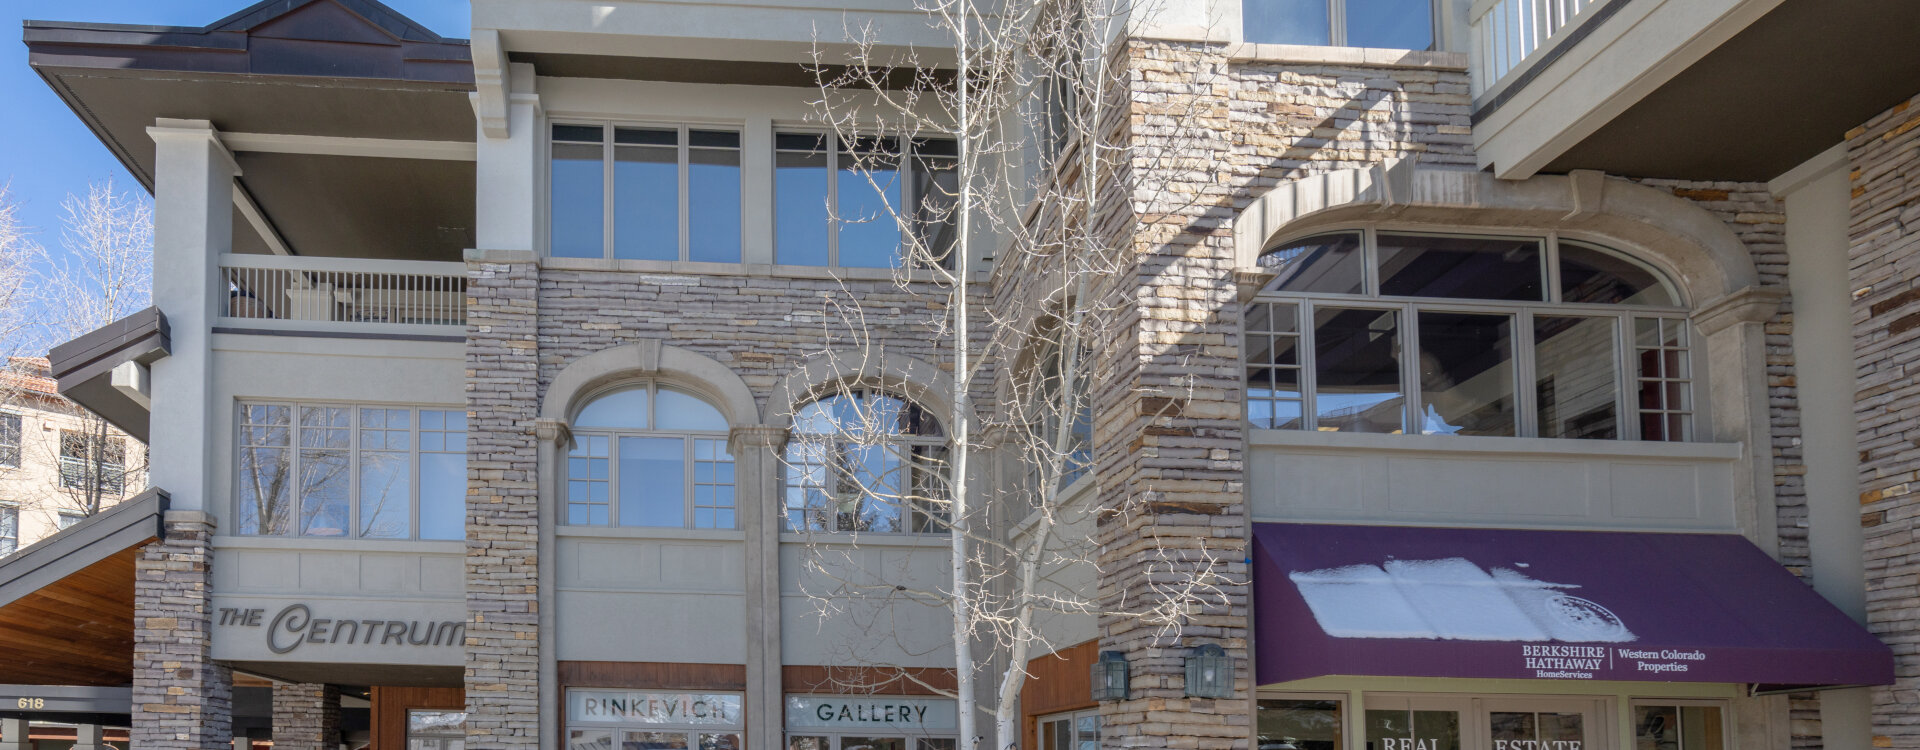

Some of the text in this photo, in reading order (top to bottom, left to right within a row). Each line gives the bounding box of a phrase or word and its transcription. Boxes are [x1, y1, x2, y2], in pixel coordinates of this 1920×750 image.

[219, 608, 264, 626] THE
[1522, 645, 1605, 658] BERKSHIRE
[1618, 648, 1706, 661] Western Colorado
[1525, 657, 1603, 670] HATHAWAY
[1637, 661, 1688, 674] Properties
[1536, 669, 1593, 679] HomeServices
[17, 697, 44, 709] 618
[585, 698, 726, 719] RINKEVICH
[816, 703, 928, 724] GALLERY
